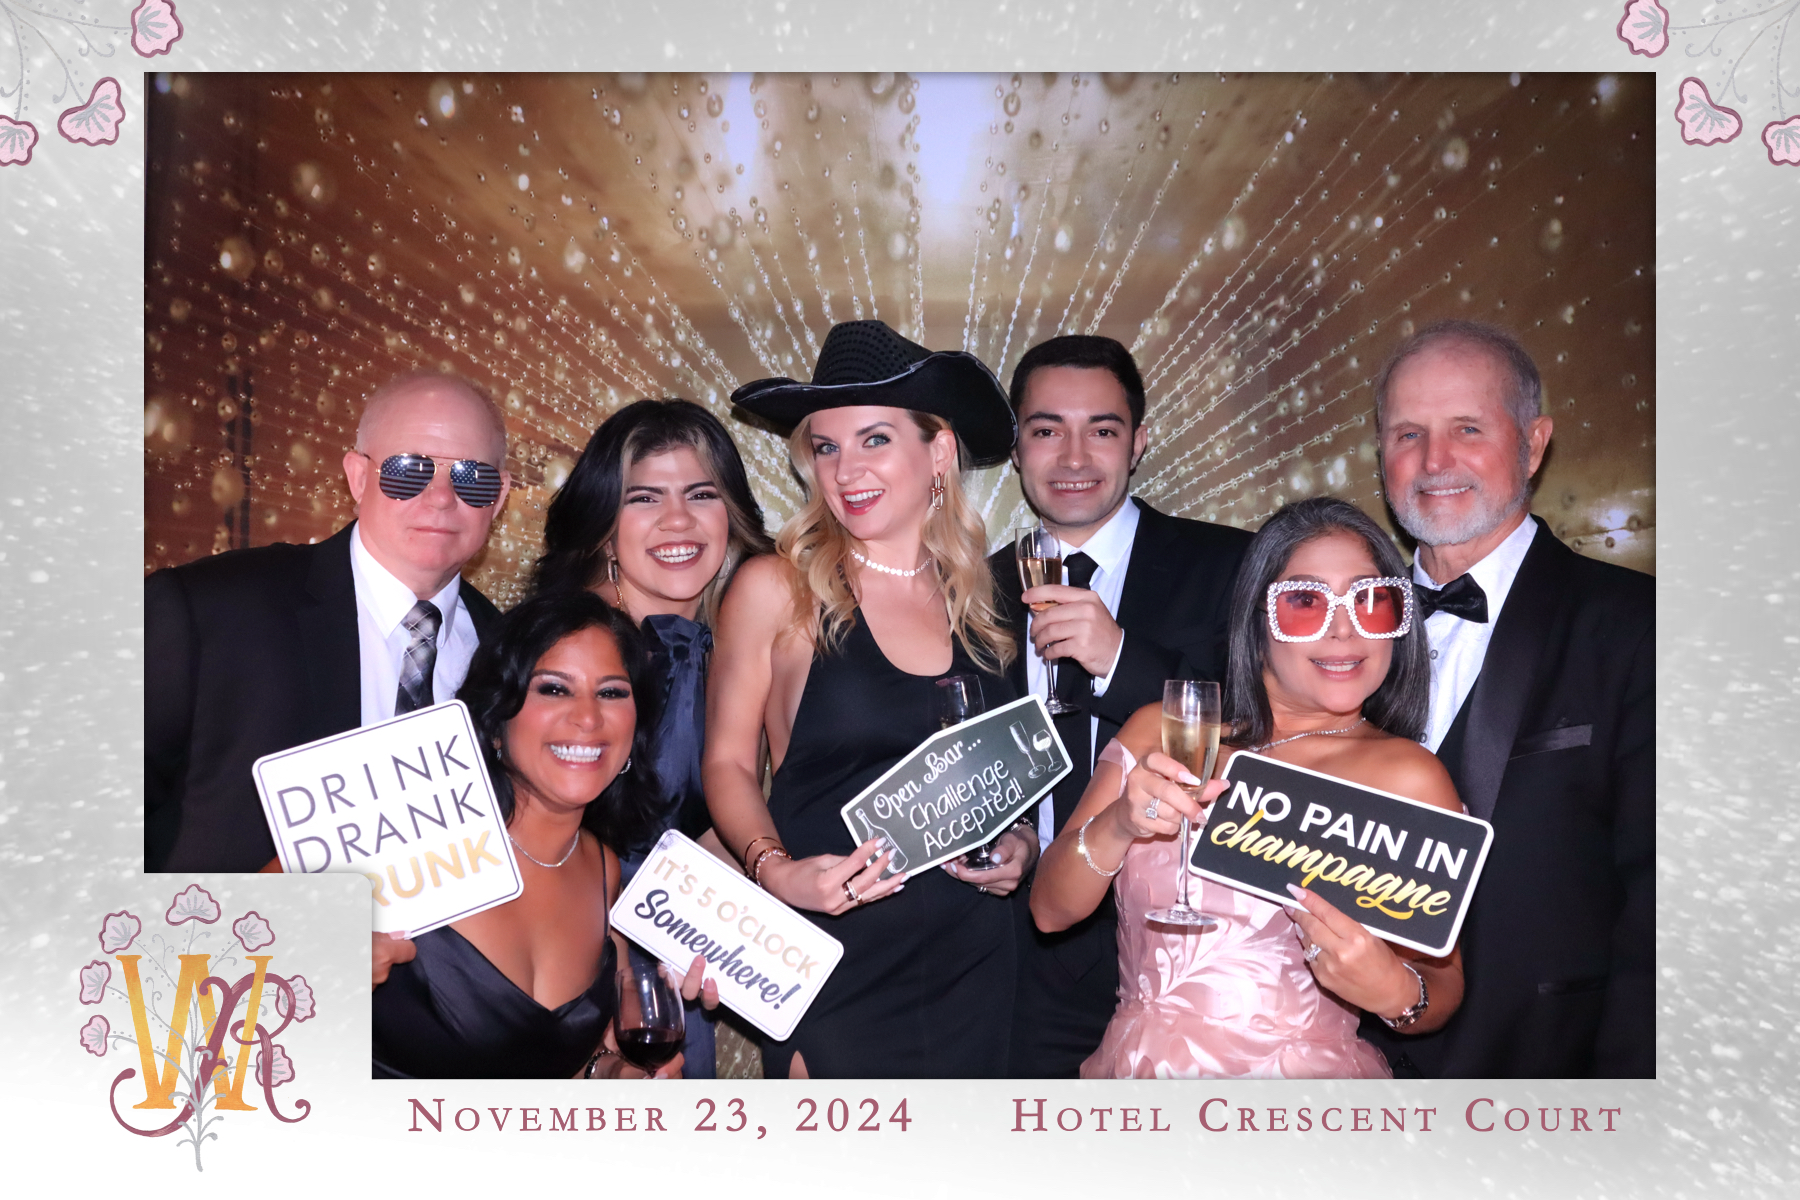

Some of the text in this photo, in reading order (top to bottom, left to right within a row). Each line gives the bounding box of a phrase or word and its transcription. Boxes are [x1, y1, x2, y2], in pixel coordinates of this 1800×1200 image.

[277, 734, 471, 828] DRINK
[873, 737, 982, 818] Open Bar...
[909, 759, 1010, 831] Challenge
[923, 776, 1026, 858] Accepted!
[292, 781, 486, 874] DRANK
[364, 829, 504, 908] RUNK
[1210, 808, 1452, 920] champagne
[1226, 780, 1468, 880] NO PAIN IN
[634, 888, 803, 1010] Somewhere!
[653, 855, 821, 981] IT'S 5 O'CLOCK
